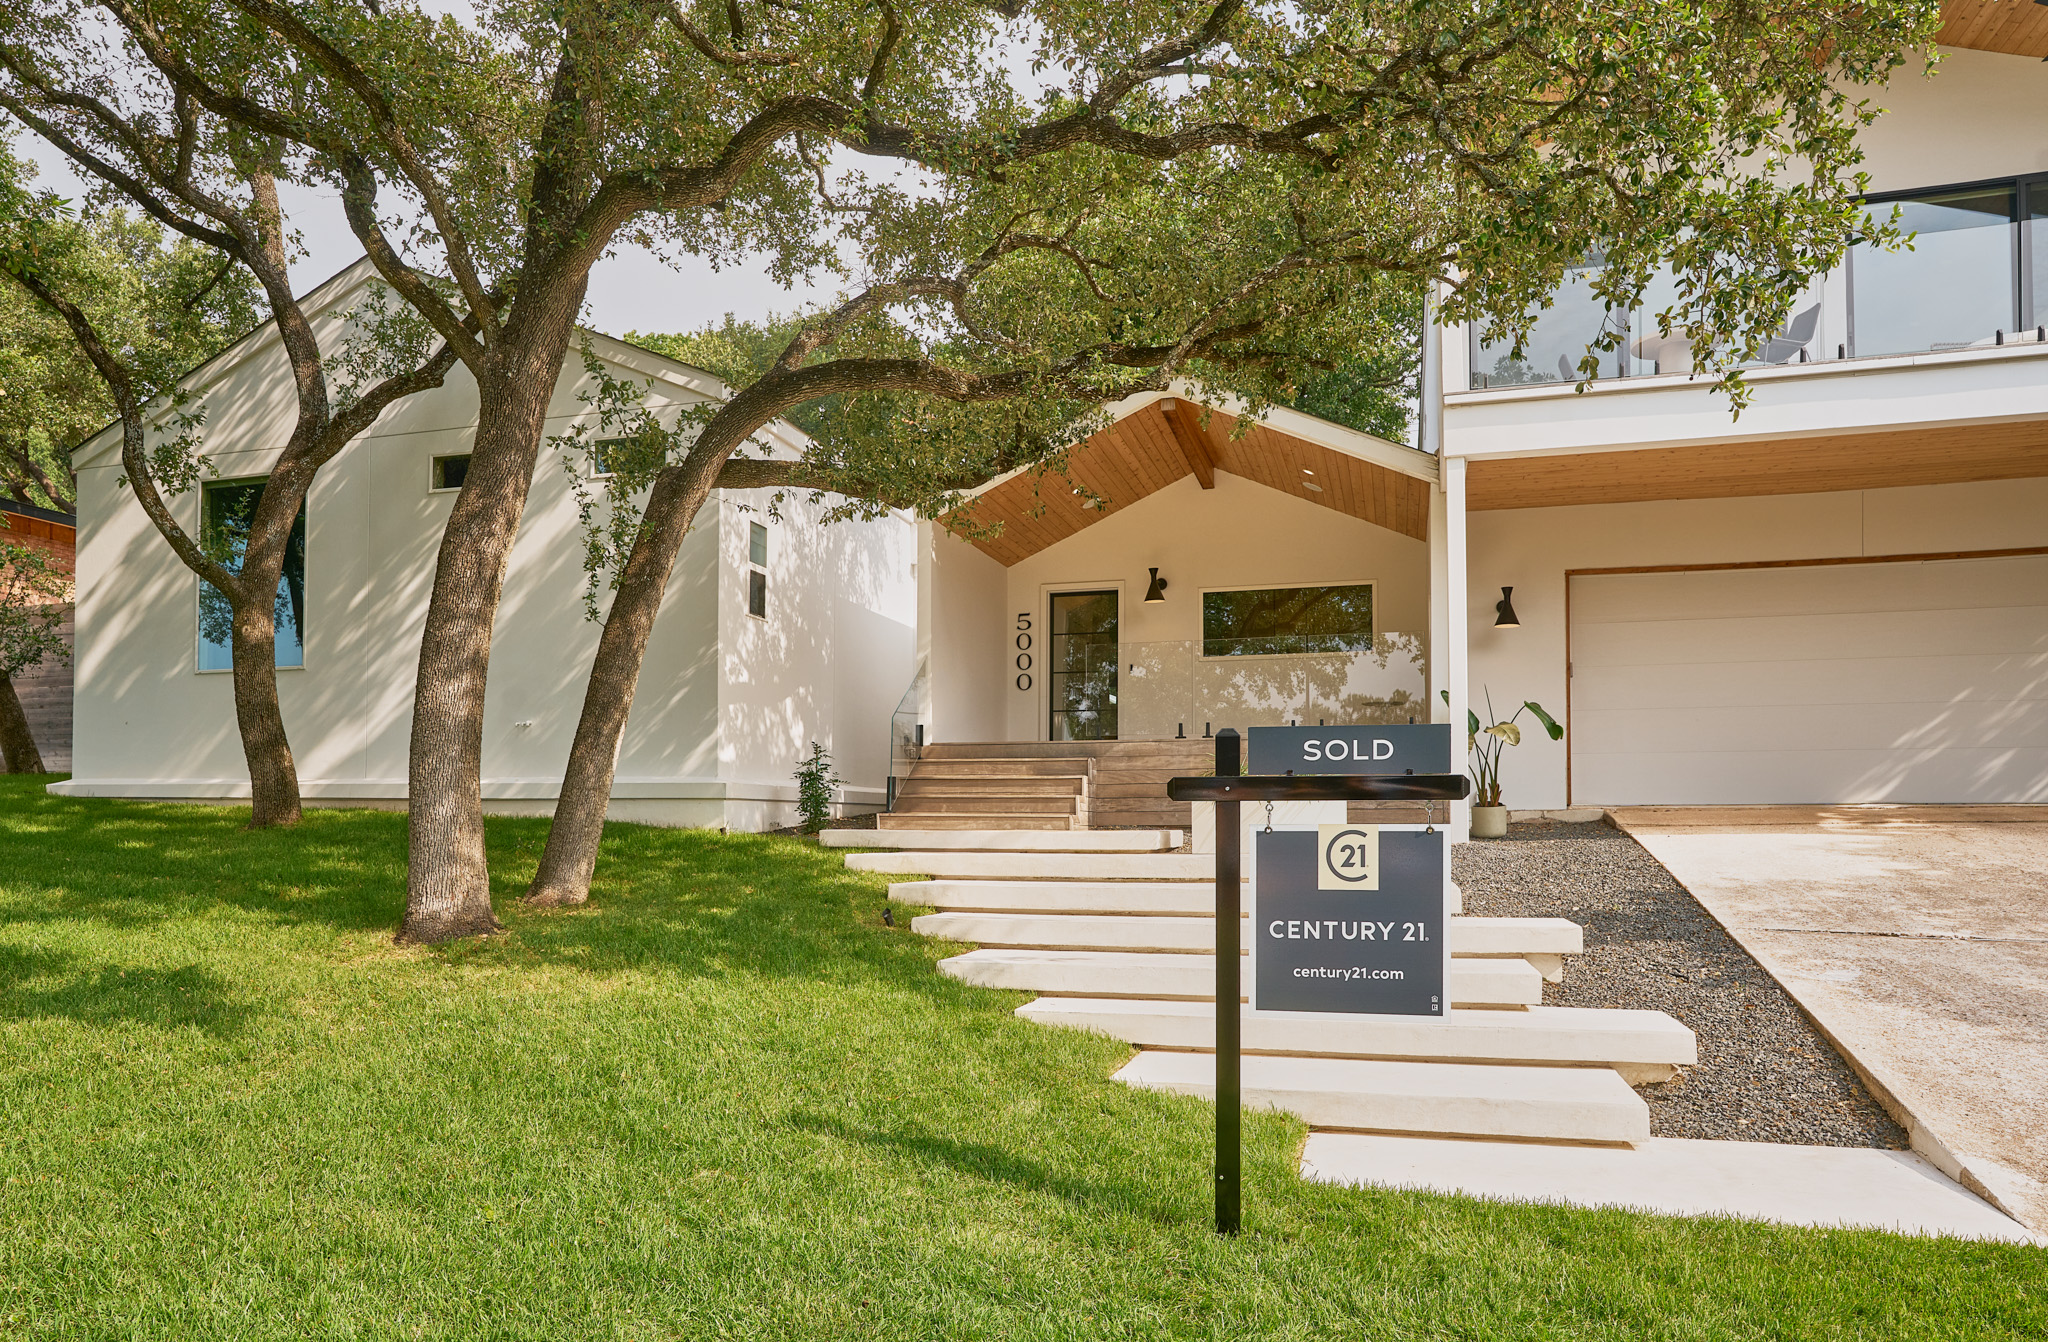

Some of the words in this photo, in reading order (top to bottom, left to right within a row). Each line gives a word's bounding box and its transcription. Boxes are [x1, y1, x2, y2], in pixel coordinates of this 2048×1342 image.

[1016, 612, 1032, 691] 5000
[1303, 739, 1394, 761] SOLD
[1269, 920, 1395, 941] CENTURY
[1293, 966, 1404, 981] century21.com
